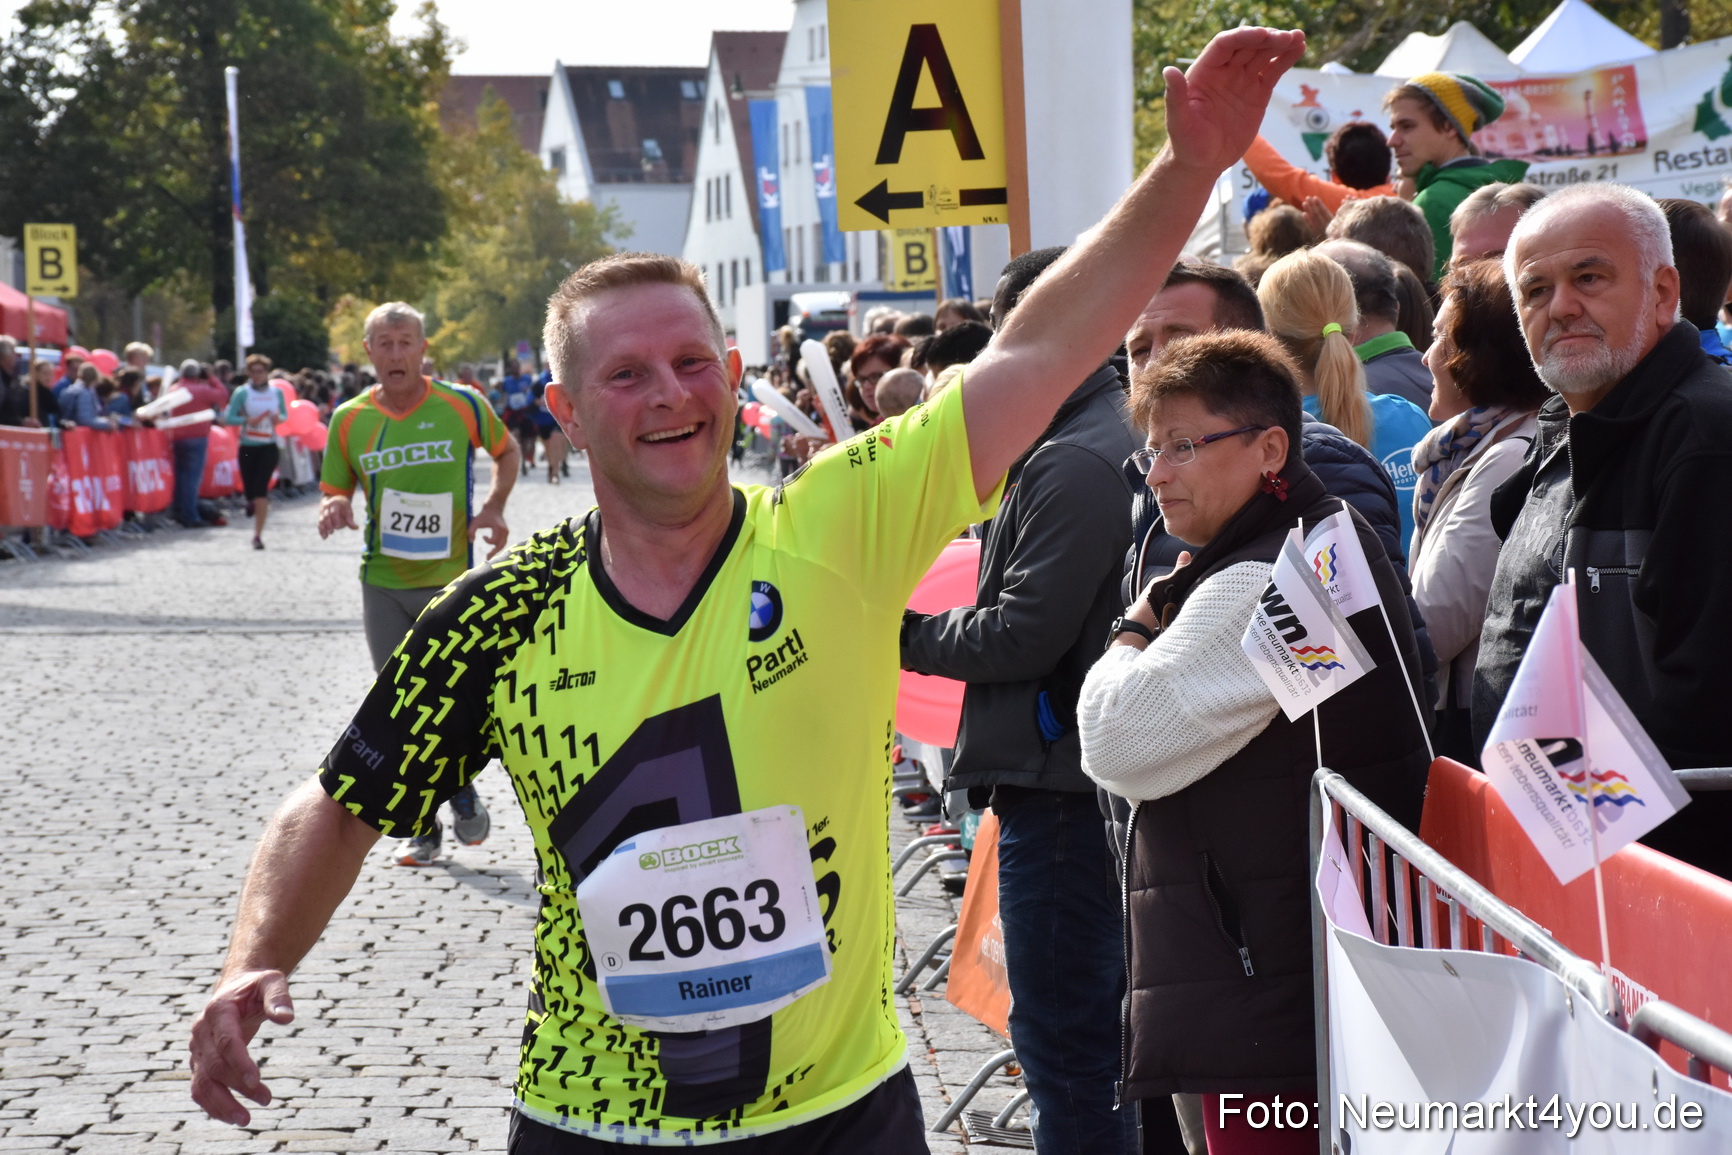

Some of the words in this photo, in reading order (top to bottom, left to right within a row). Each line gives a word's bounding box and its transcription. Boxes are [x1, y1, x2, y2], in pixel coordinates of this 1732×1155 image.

[875, 23, 985, 165] A
[1597, 163, 1619, 181] 21
[1654, 147, 1732, 172] Resta
[1681, 182, 1725, 197] Vega
[39, 247, 63, 279] B
[905, 243, 928, 274] B
[359, 440, 455, 475] BOCK
[390, 511, 440, 534] 2748
[746, 628, 804, 682] Partl
[1264, 627, 1299, 676] neumarkt
[751, 651, 809, 694] Neumarkt
[345, 723, 385, 771] Partl
[661, 835, 742, 867] BOCK
[664, 862, 689, 873] inspired
[699, 858, 717, 868] smart
[717, 853, 745, 863] concepts
[618, 878, 787, 962] 2663
[607, 956, 617, 968] D
[678, 974, 753, 1001] Rainer
